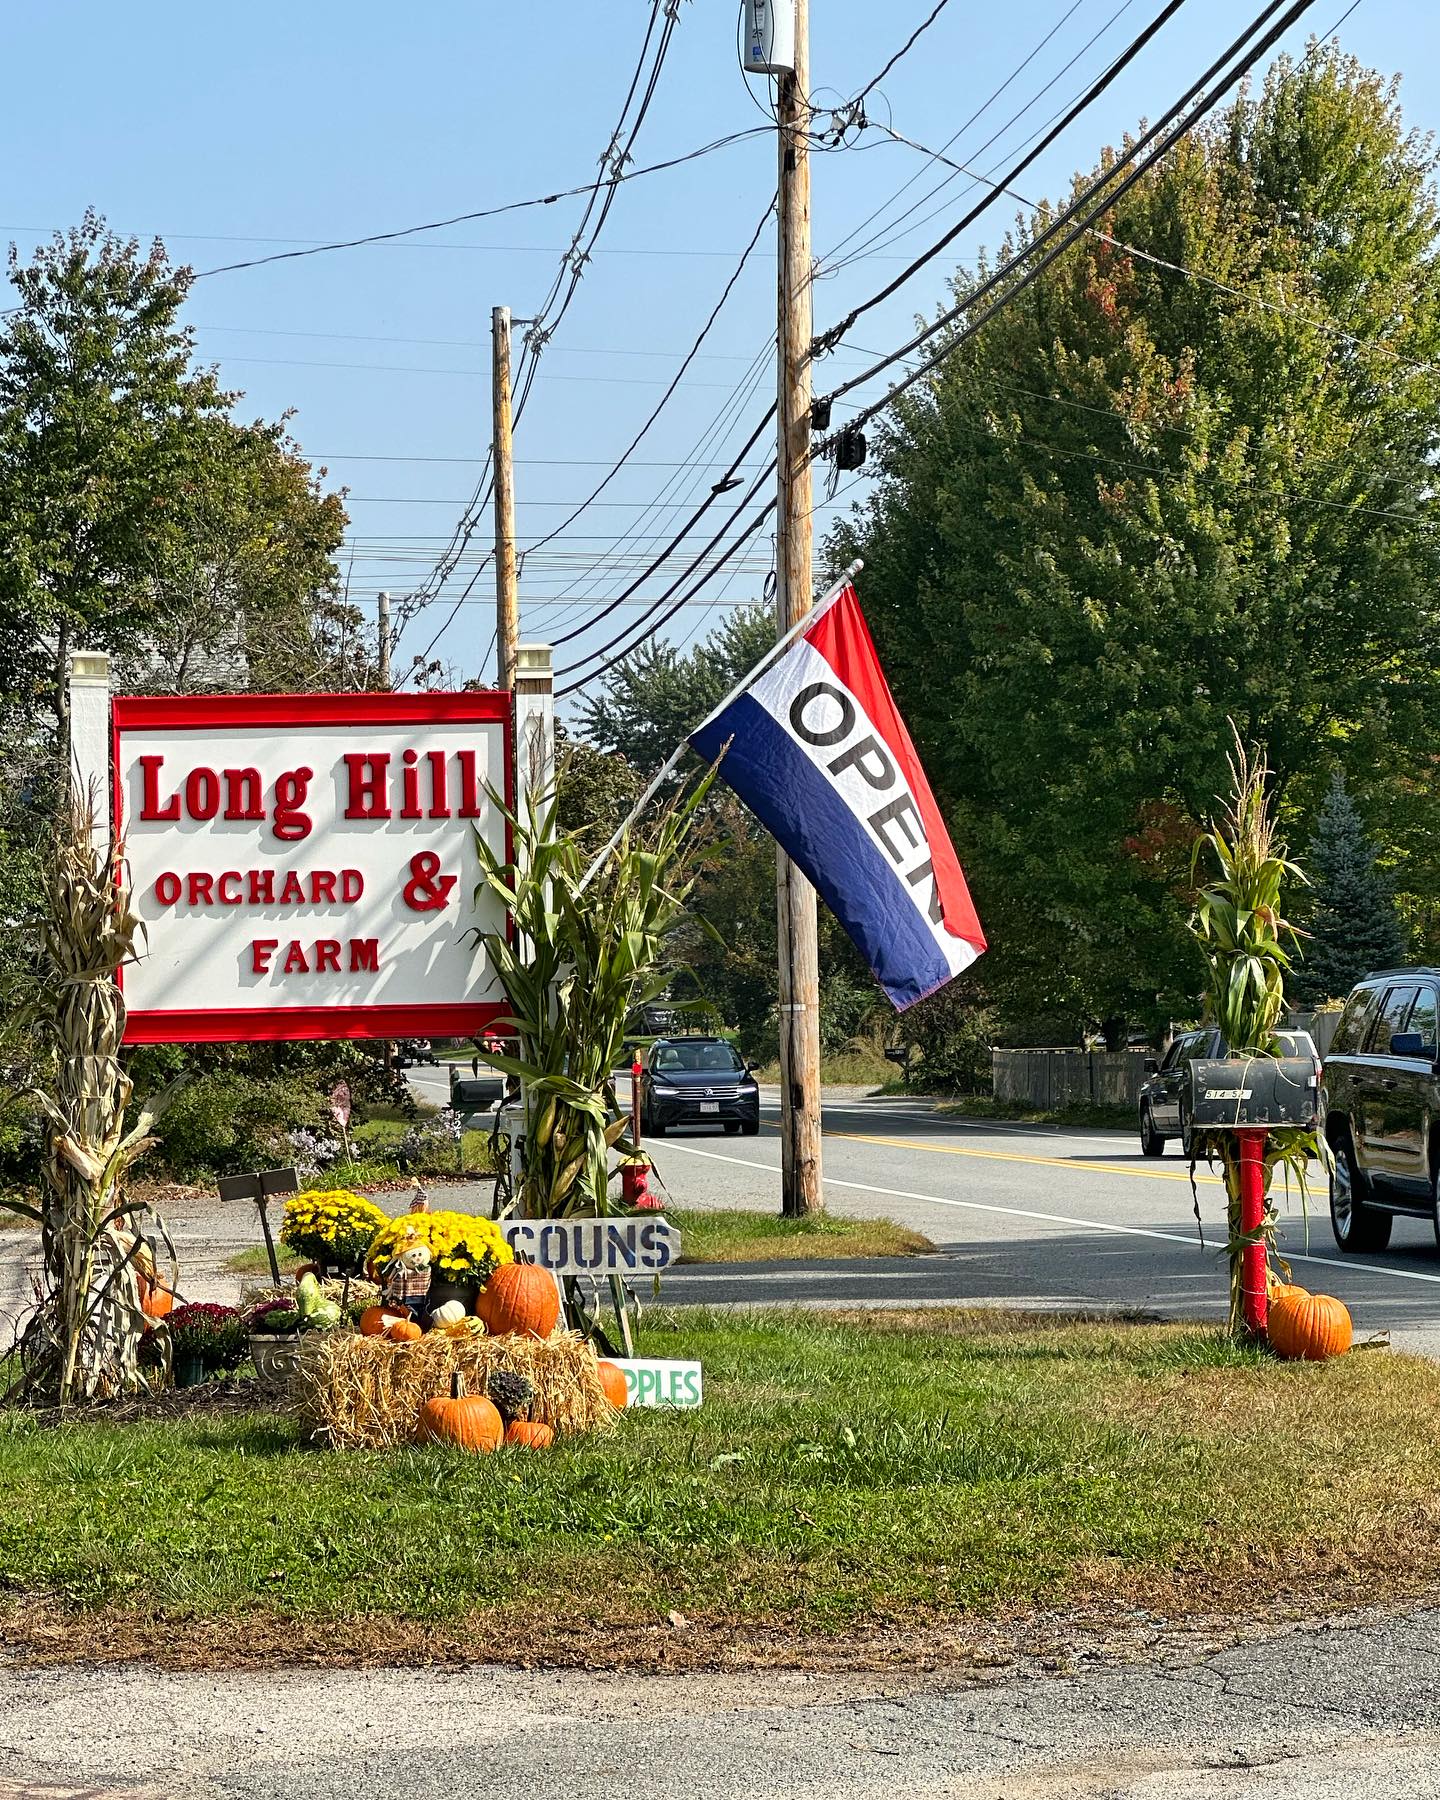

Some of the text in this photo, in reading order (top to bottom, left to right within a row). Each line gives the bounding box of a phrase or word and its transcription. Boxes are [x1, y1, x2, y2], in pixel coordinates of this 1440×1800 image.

[140, 749, 481, 840] Long Hill
[155, 851, 458, 911] ORCHARD &
[252, 938, 380, 974] FARM
